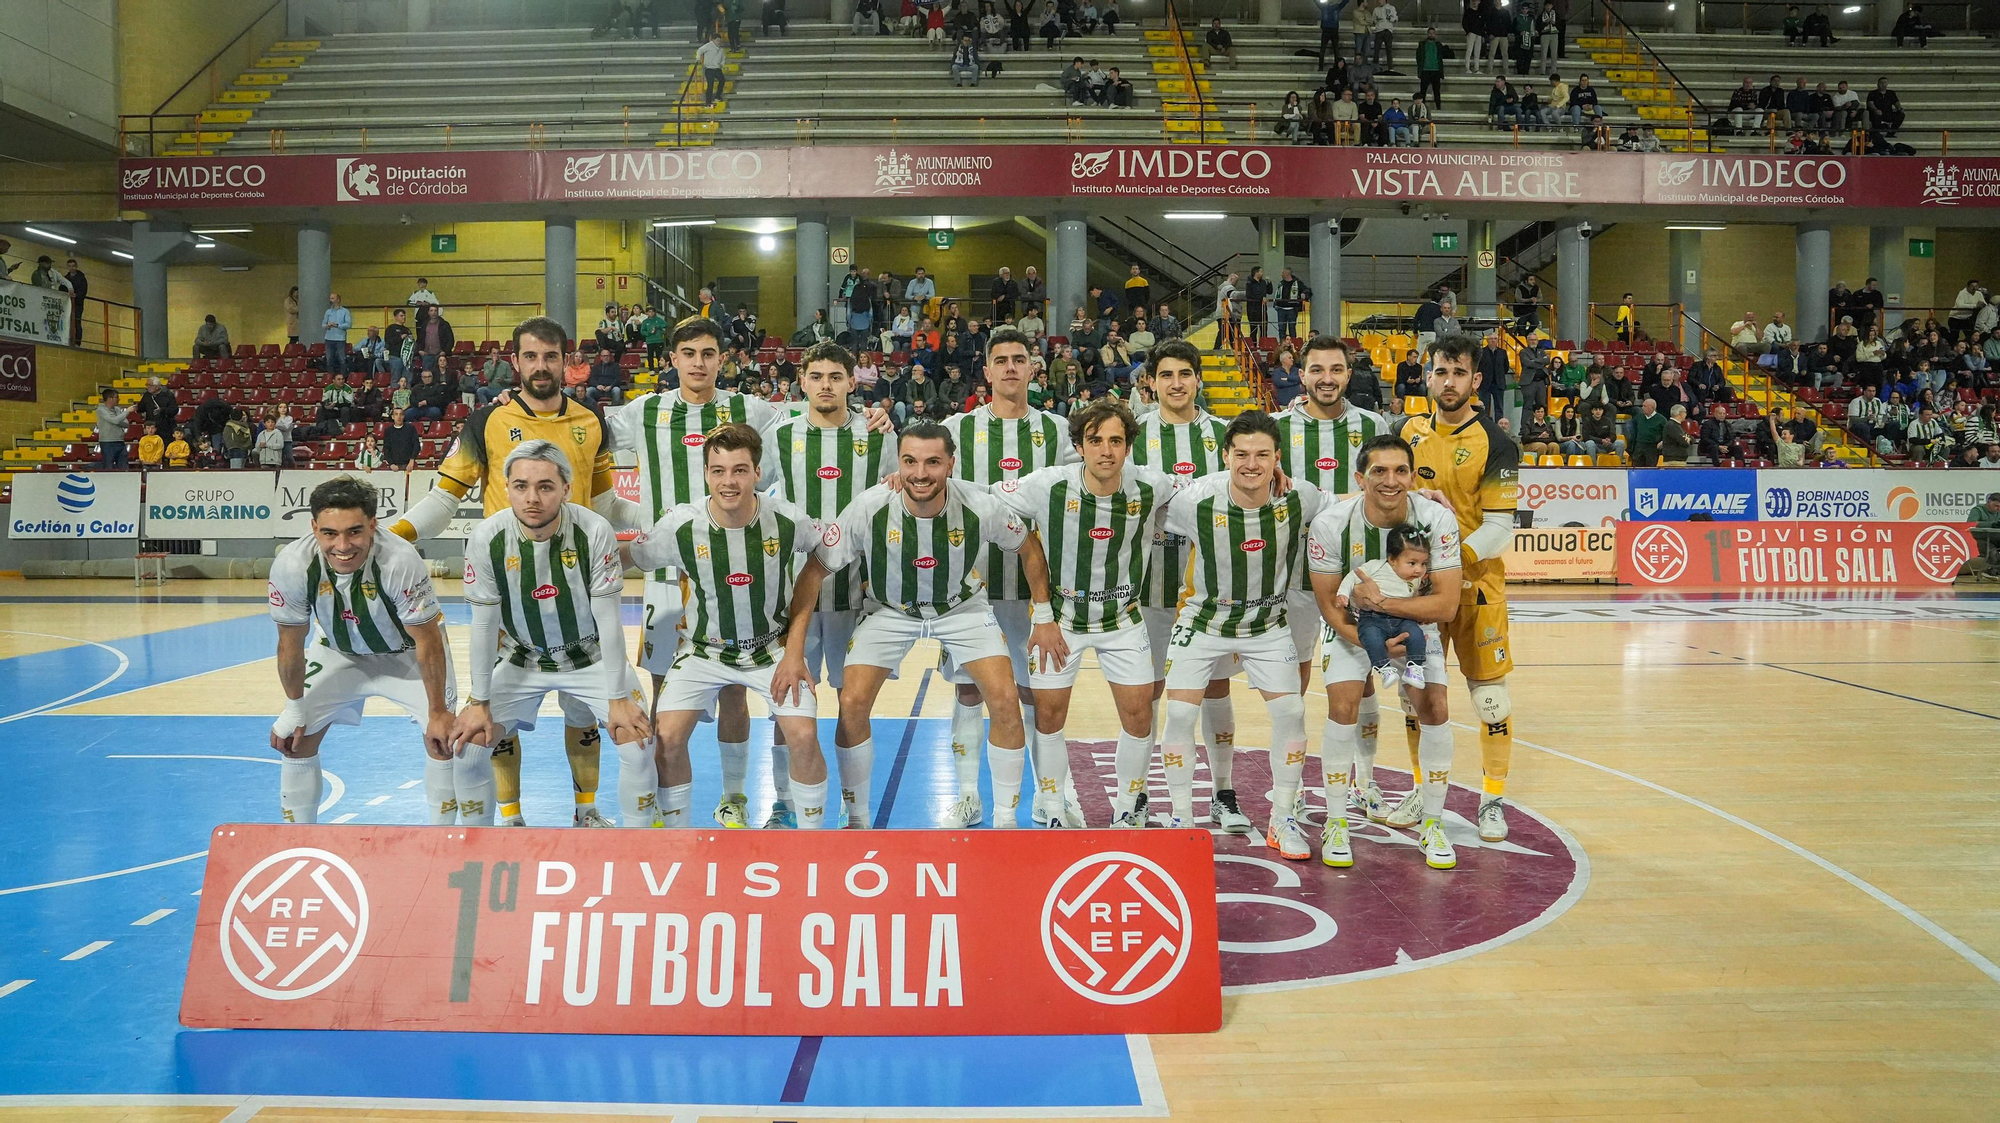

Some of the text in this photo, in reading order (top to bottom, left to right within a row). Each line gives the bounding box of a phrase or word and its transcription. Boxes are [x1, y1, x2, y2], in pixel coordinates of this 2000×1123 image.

[609, 151, 762, 181] IMDECO
[915, 156, 993, 170] AYUNTAMIENTO
[1118, 150, 1272, 179] IMDECO
[1366, 153, 1563, 167] PALACIO MUNICIPAL DEPORTES
[156, 165, 266, 188] IMDECO
[386, 165, 466, 182] Diputación
[916, 171, 981, 186] DE CÓRDOBA
[1701, 159, 1846, 189] IMDECO
[1962, 168, 2000, 181] AYUNTA
[387, 181, 467, 195] de Córdoba
[1072, 184, 1270, 195] Instituto Municipal de Deportes Córdoba
[1351, 169, 1582, 198] VISTA ALEGRE
[1962, 184, 1975, 197] DE
[154, 192, 189, 201] Municipal
[190, 191, 199, 199] de
[201, 191, 233, 200] Deportes
[565, 188, 604, 198] Instituto
[607, 187, 654, 198] Municipal
[656, 187, 669, 196] de
[1658, 193, 1845, 204] Instituto Municipal de Deportes Córdoba
[439, 238, 447, 249] F
[936, 231, 948, 245] G
[1440, 235, 1450, 248] H
[184, 489, 235, 502] GRUPO
[1661, 493, 1751, 510] IMANE
[1796, 490, 1870, 501] BOBINADOS
[150, 505, 271, 520] ROSMARINO
[1796, 503, 1870, 518] PASTOR
[13, 520, 135, 537] Gestión y Calor
[1737, 524, 1892, 542] DIVISIÓN
[1650, 544, 1669, 553] RF
[1930, 545, 1951, 553] RF
[1650, 555, 1669, 564] EF
[1737, 542, 1898, 583] FÚTBOL SALA
[1931, 556, 1952, 564] EF
[646, 604, 655, 631] 2
[1170, 624, 1197, 648] 23
[536, 851, 958, 896] DIVISIÓN
[270, 898, 323, 918] RF
[1090, 902, 1142, 923] RF
[266, 927, 319, 947] EF
[448, 860, 520, 1003] 1ª
[1091, 931, 1143, 953] EF
[525, 897, 964, 1008] FÚTBOL SALA
